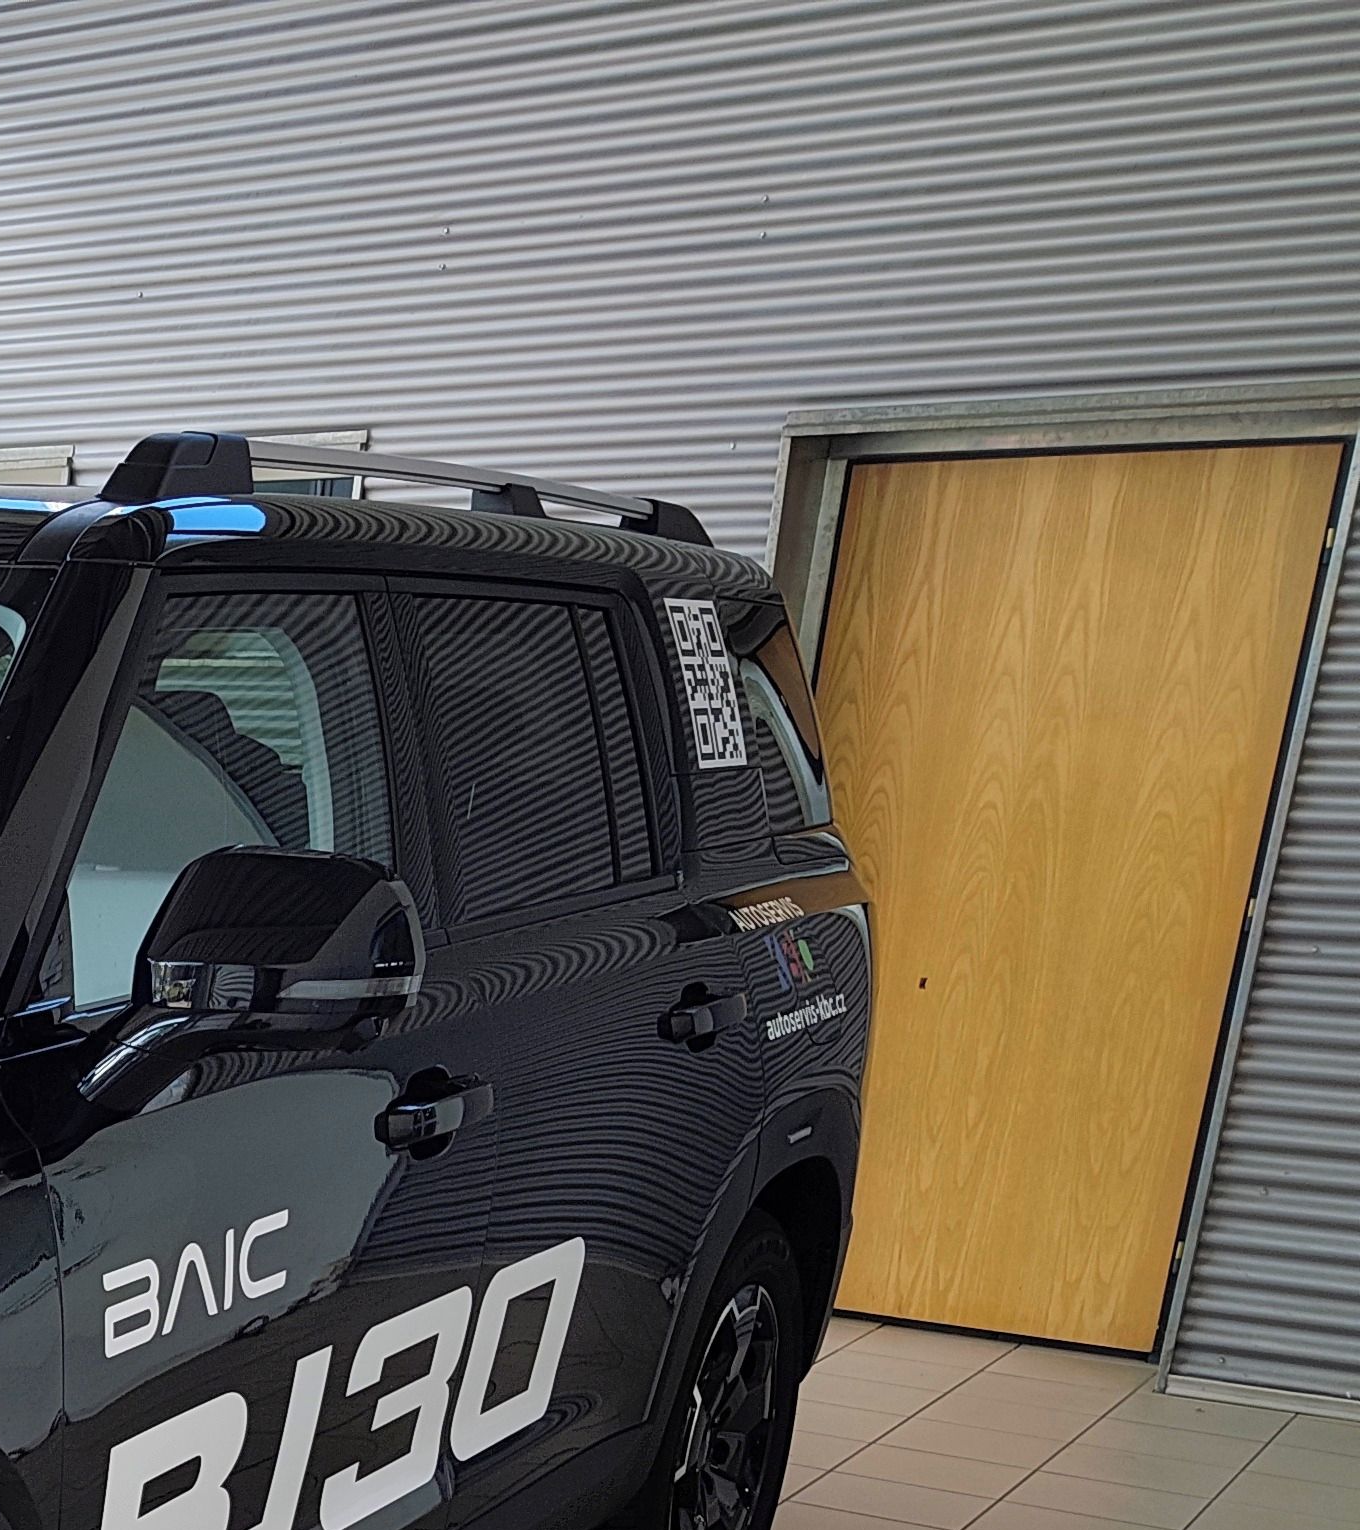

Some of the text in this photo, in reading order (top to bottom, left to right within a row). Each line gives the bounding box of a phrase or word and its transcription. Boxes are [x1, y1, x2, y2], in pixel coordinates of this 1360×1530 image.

[728, 896, 805, 932] AUTOSERVIS
[766, 992, 848, 1041] autoservis-kbc.cz
[102, 1209, 289, 1358] BAIC
